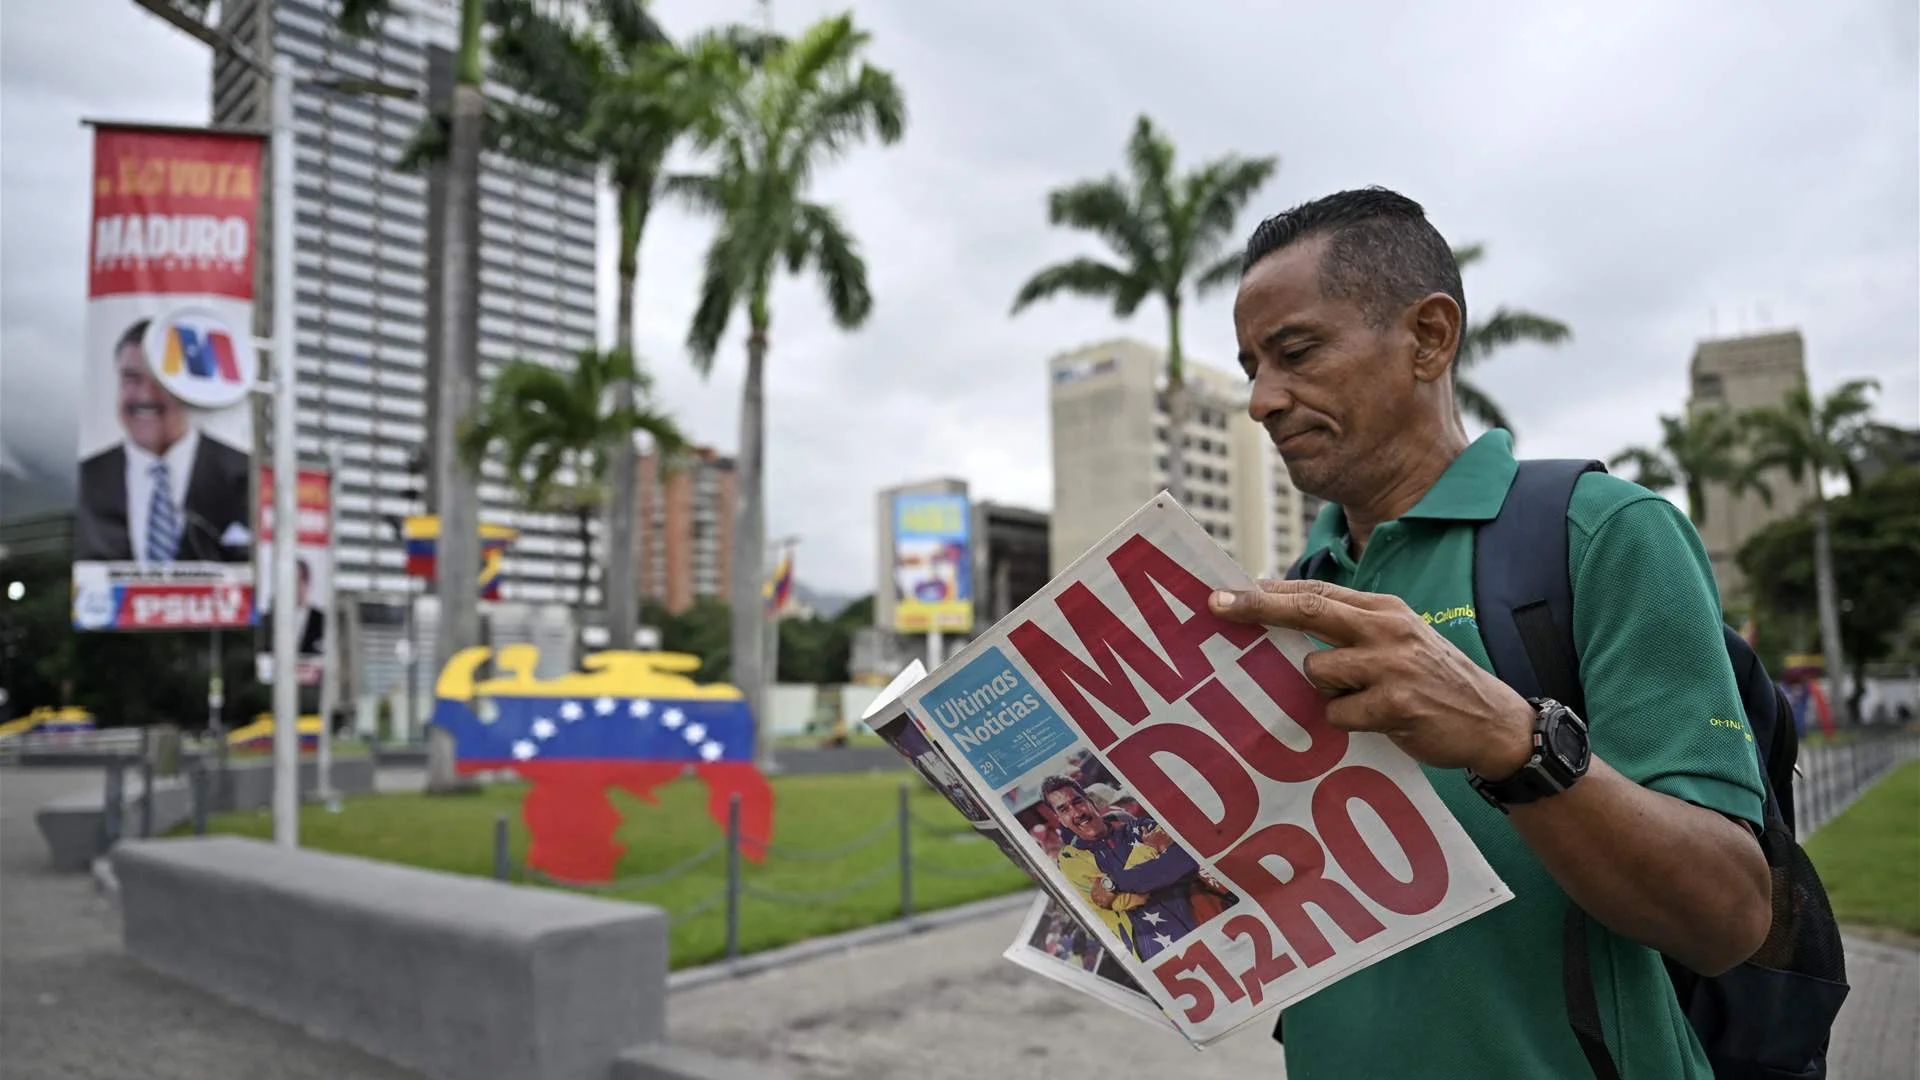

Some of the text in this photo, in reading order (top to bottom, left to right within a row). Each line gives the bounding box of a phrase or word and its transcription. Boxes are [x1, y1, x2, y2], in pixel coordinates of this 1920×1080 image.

[95, 213, 250, 262] MADURO
[132, 582, 243, 625] PSUV
[953, 692, 1040, 752] Noticias
[979, 761, 994, 775] 29
[1213, 765, 1450, 968] RO
[1152, 914, 1297, 1025] 51,2
